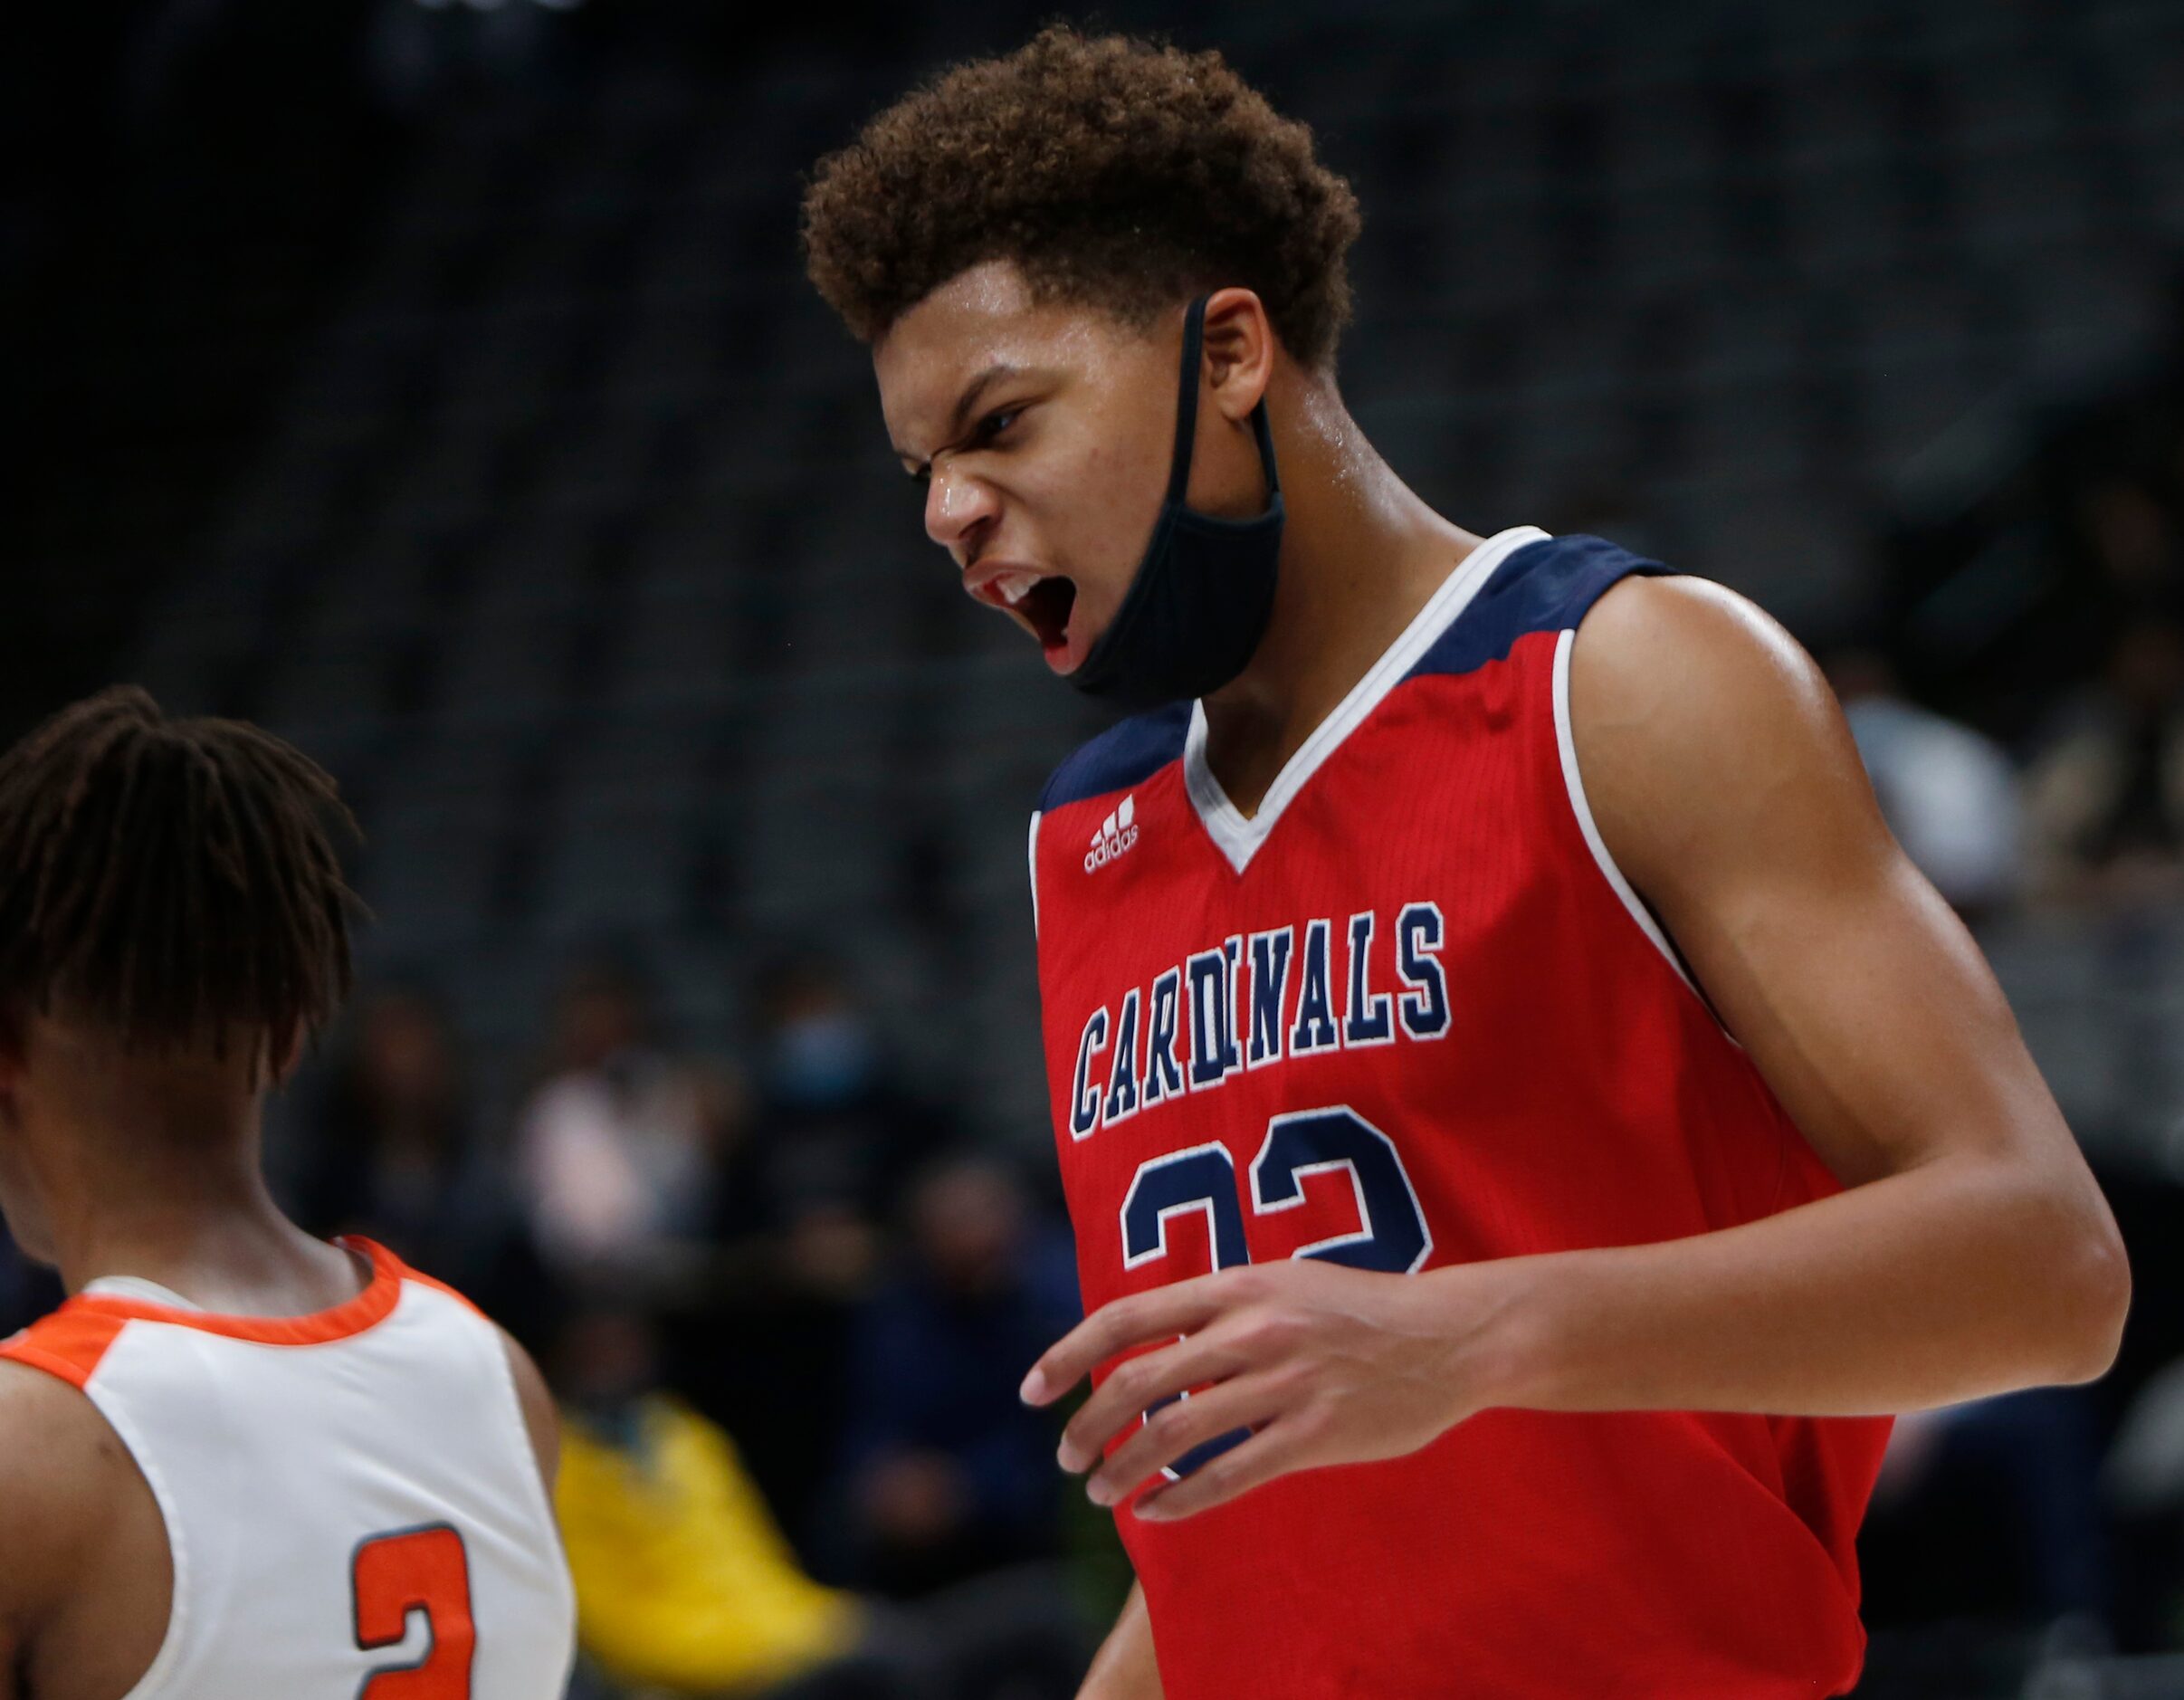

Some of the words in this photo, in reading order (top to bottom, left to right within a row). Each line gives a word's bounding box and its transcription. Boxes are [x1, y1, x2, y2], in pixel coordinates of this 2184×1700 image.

[1083, 824, 1139, 875] adidas
[1069, 901, 1453, 1141] CARDINALS
[348, 1520, 477, 1700] 2
